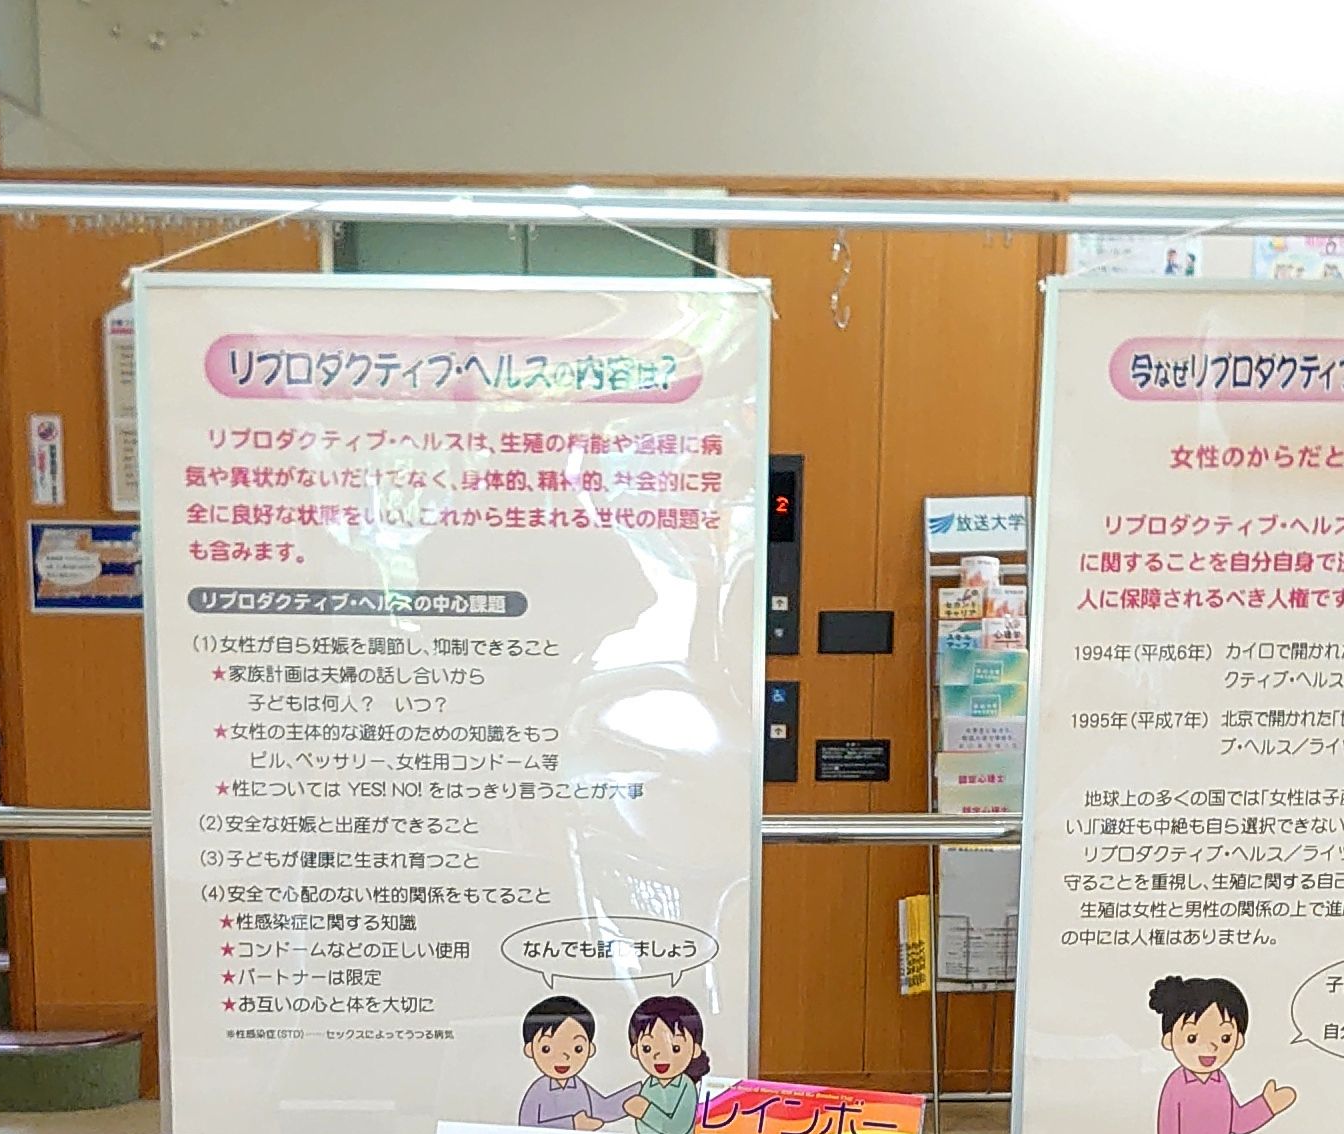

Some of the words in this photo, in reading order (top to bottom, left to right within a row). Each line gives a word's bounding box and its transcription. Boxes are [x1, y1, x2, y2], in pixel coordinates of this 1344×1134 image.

[775, 496, 789, 513] 2
[957, 513, 1025, 532] 放送大学
[189, 540, 306, 565] も含みます。
[227, 664, 485, 686] 家族計画は夫婦の話し合いから
[231, 721, 560, 743] 女性の主体的な避妊のための知識をもつ
[349, 780, 387, 798] YES!
[391, 780, 423, 799] NO!
[236, 912, 417, 933] 性感染症に関する知識
[237, 940, 471, 960] コンドームなどの正しい使用
[239, 969, 383, 988] パートナーは限定
[238, 995, 435, 1014] お互いの心と体を大切に
